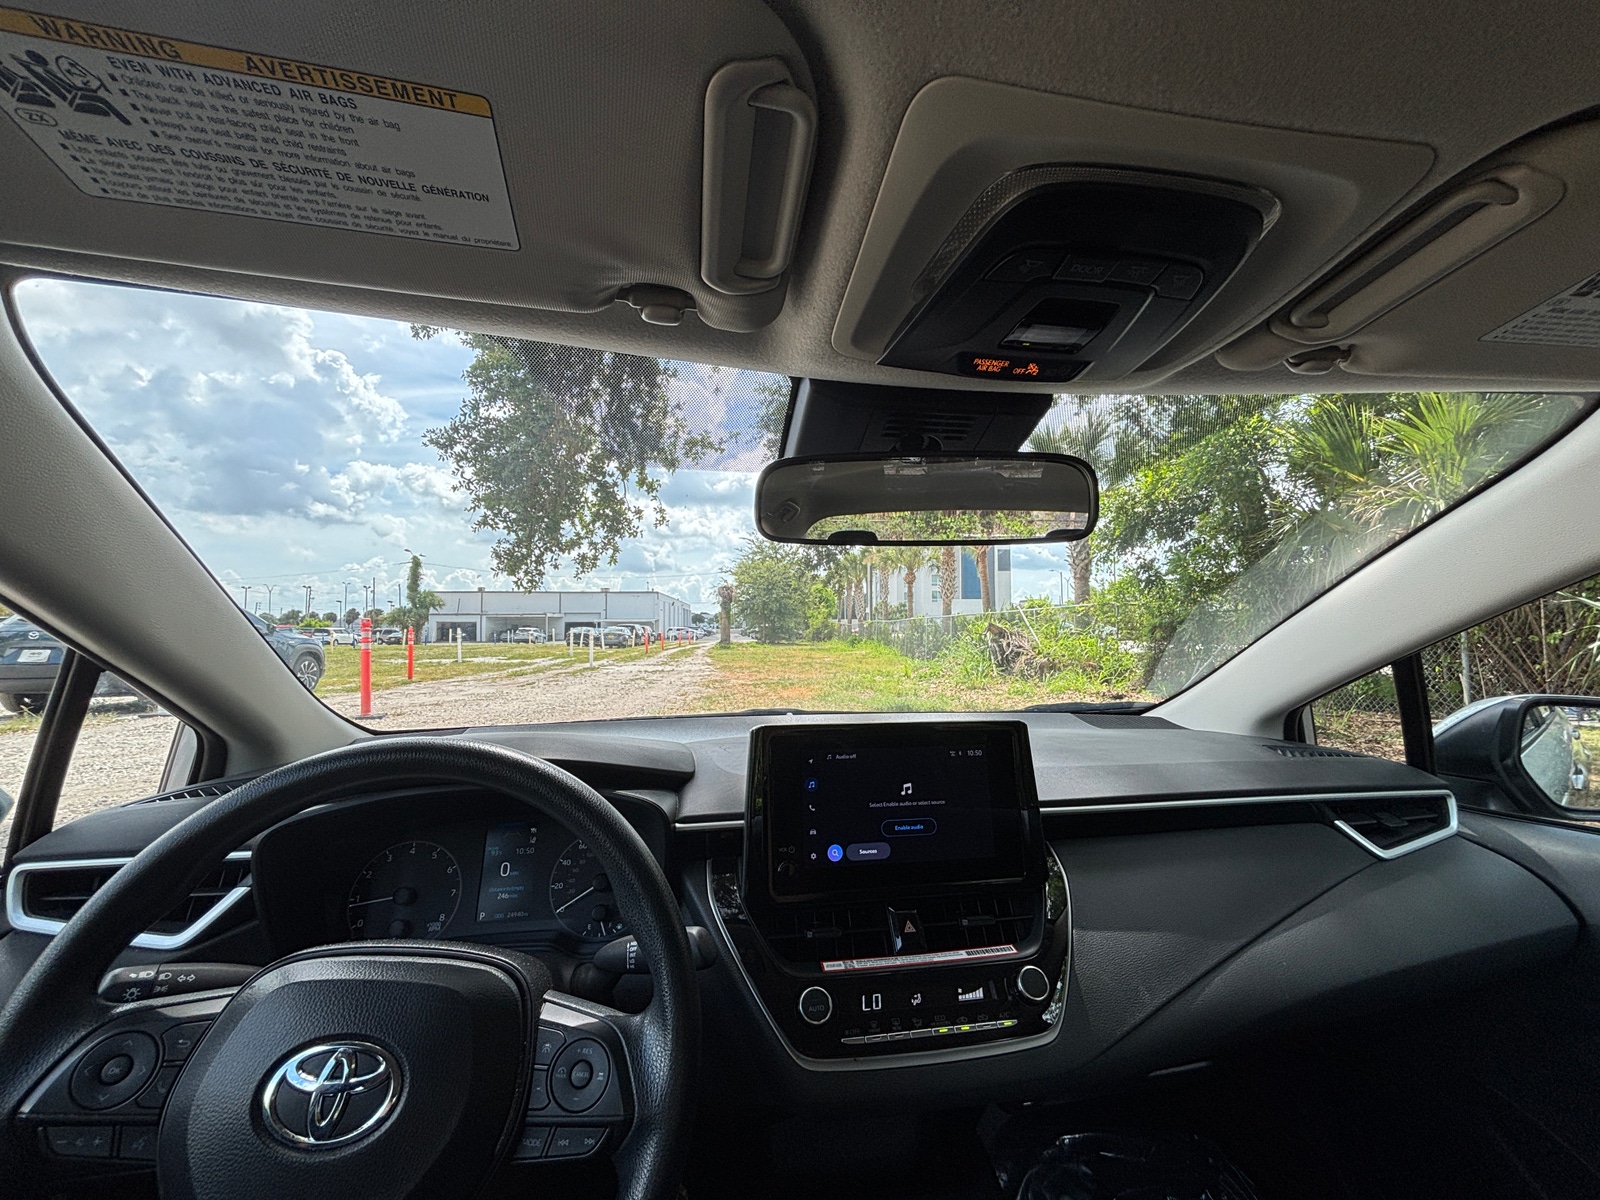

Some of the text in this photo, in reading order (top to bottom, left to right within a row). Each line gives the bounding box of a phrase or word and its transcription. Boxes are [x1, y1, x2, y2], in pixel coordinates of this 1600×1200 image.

[29, 15, 183, 60] WARNING
[105, 55, 358, 109] EVEN WITH ADVANCED AIR BAGS
[245, 55, 458, 109] AVERTISSEMENT
[118, 72, 401, 132] Children can be killed or seriously injured by the air bag
[130, 88, 152, 100] The
[206, 102, 219, 111] is
[220, 103, 238, 114] the
[239, 106, 270, 120] safest
[272, 112, 300, 126] place
[301, 117, 316, 127] for
[317, 120, 355, 134] children
[174, 110, 194, 121] put
[258, 122, 282, 134] child
[284, 128, 305, 138] seat
[307, 131, 318, 139] in
[320, 133, 336, 142] the
[338, 136, 360, 146] front
[189, 125, 208, 134] use
[210, 128, 232, 137] seat
[233, 131, 258, 141] belts
[259, 135, 278, 144] and
[280, 138, 304, 149] child
[306, 142, 347, 156] restraints
[102, 136, 144, 151] AVEC
[145, 142, 176, 156] DES
[178, 147, 246, 166] COUSSINS
[248, 158, 269, 169] DE
[269, 159, 332, 178] SÉCURITÉ
[335, 171, 353, 182] DE
[356, 174, 416, 191] NOUVELLE
[419, 182, 489, 202] GÉNÉRATION
[222, 140, 259, 153] manual
[259, 146, 274, 155] for
[276, 150, 301, 159] more
[302, 153, 351, 167] information
[352, 161, 378, 172] about
[380, 165, 392, 174] air
[394, 167, 416, 179] bags
[973, 358, 1010, 367] PASSENGER
[500, 862, 510, 877] 0
[357, 919, 364, 927] 0
[480, 912, 485, 920] P
[862, 994, 882, 1011] LO
